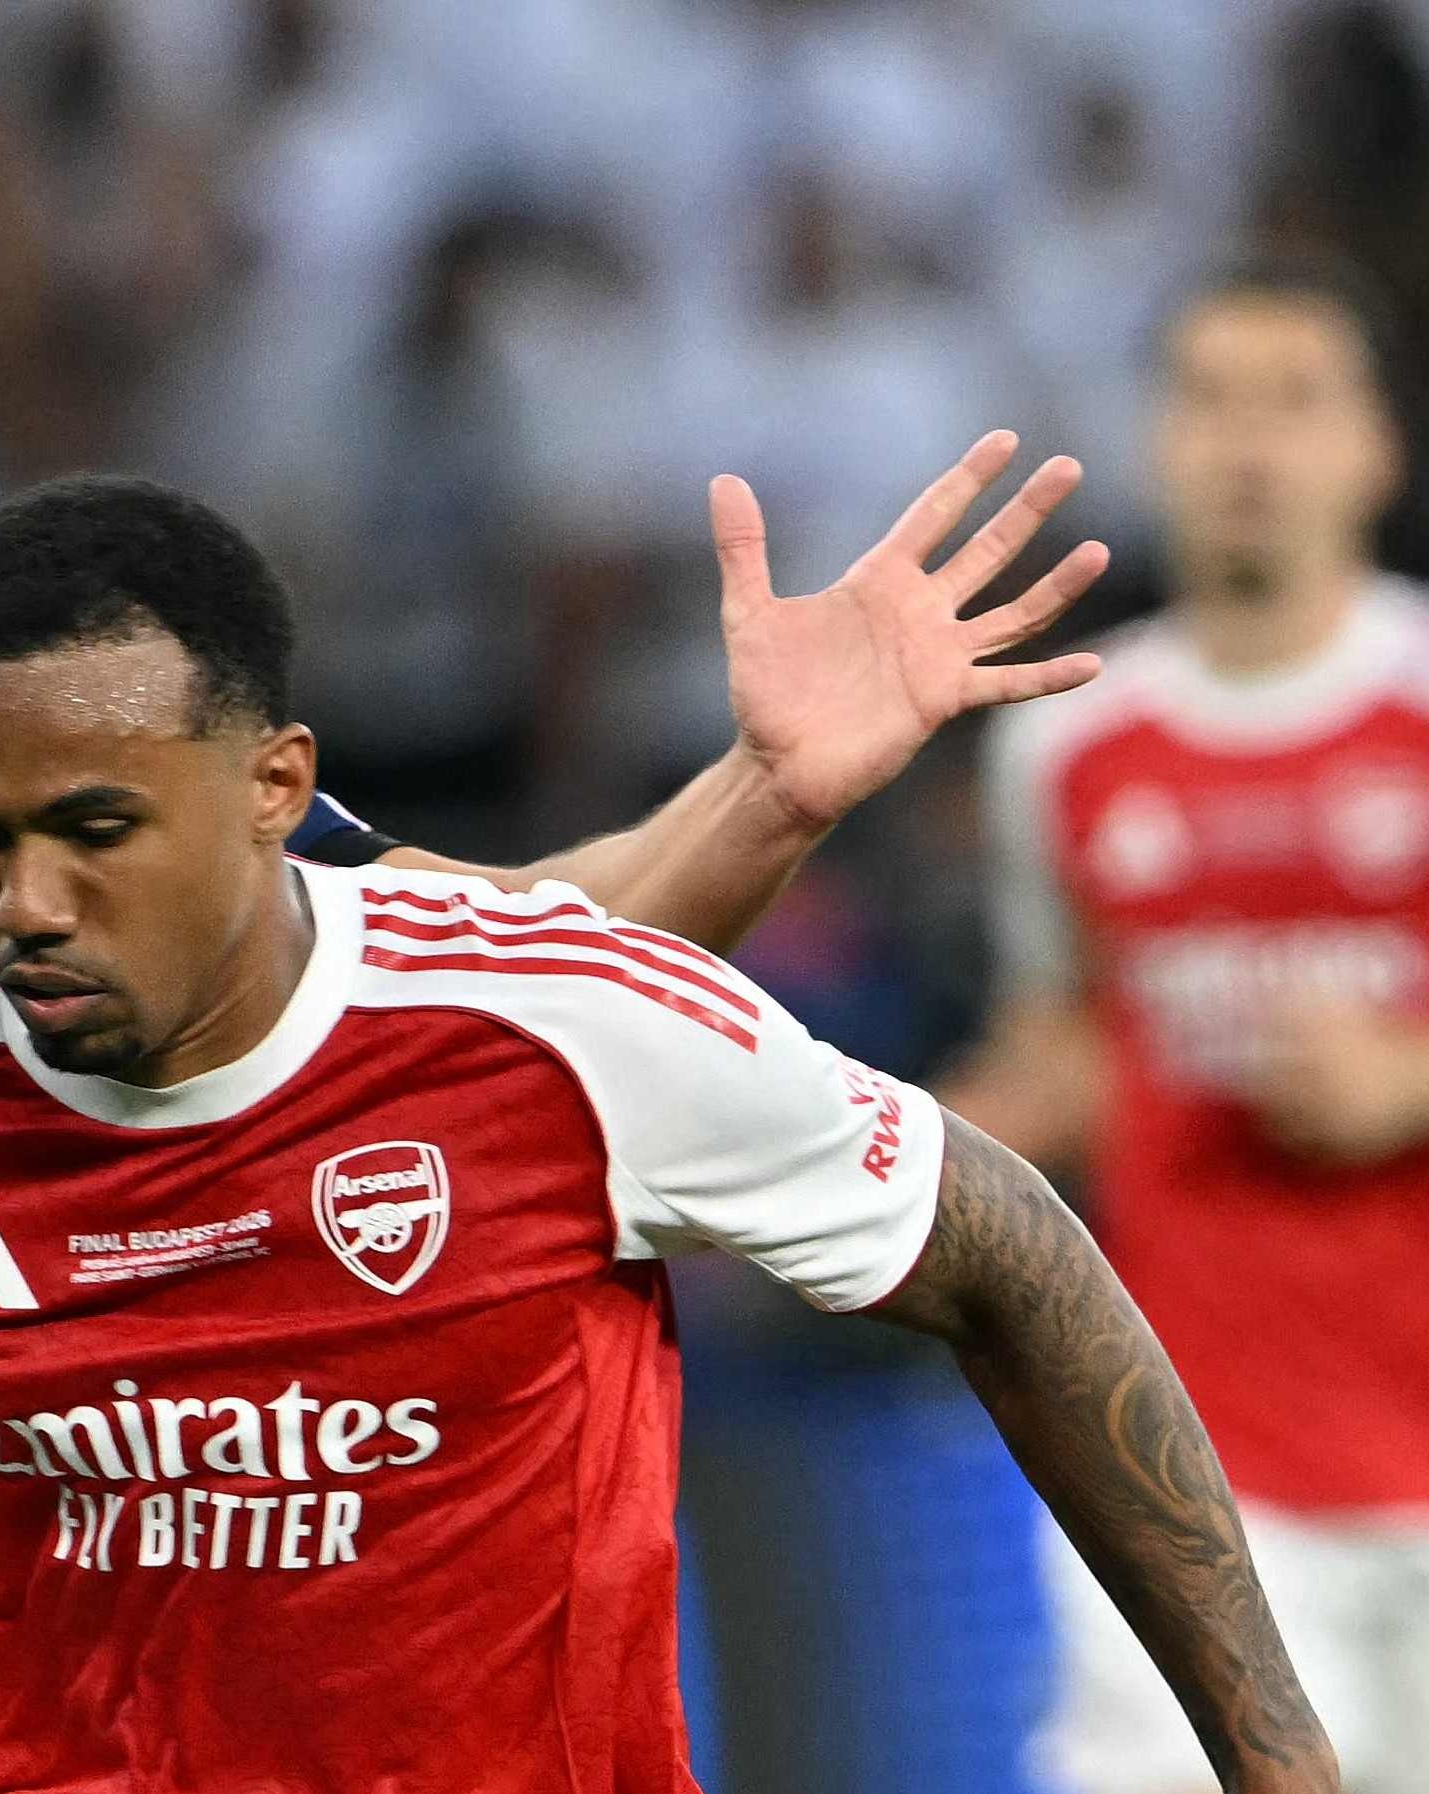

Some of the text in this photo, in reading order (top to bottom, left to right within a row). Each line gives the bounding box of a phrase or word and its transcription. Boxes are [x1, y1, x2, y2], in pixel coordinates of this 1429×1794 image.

[332, 1163, 429, 1198] Arsenal
[68, 1233, 128, 1253] FINAL
[138, 1488, 363, 1570] BETTER
